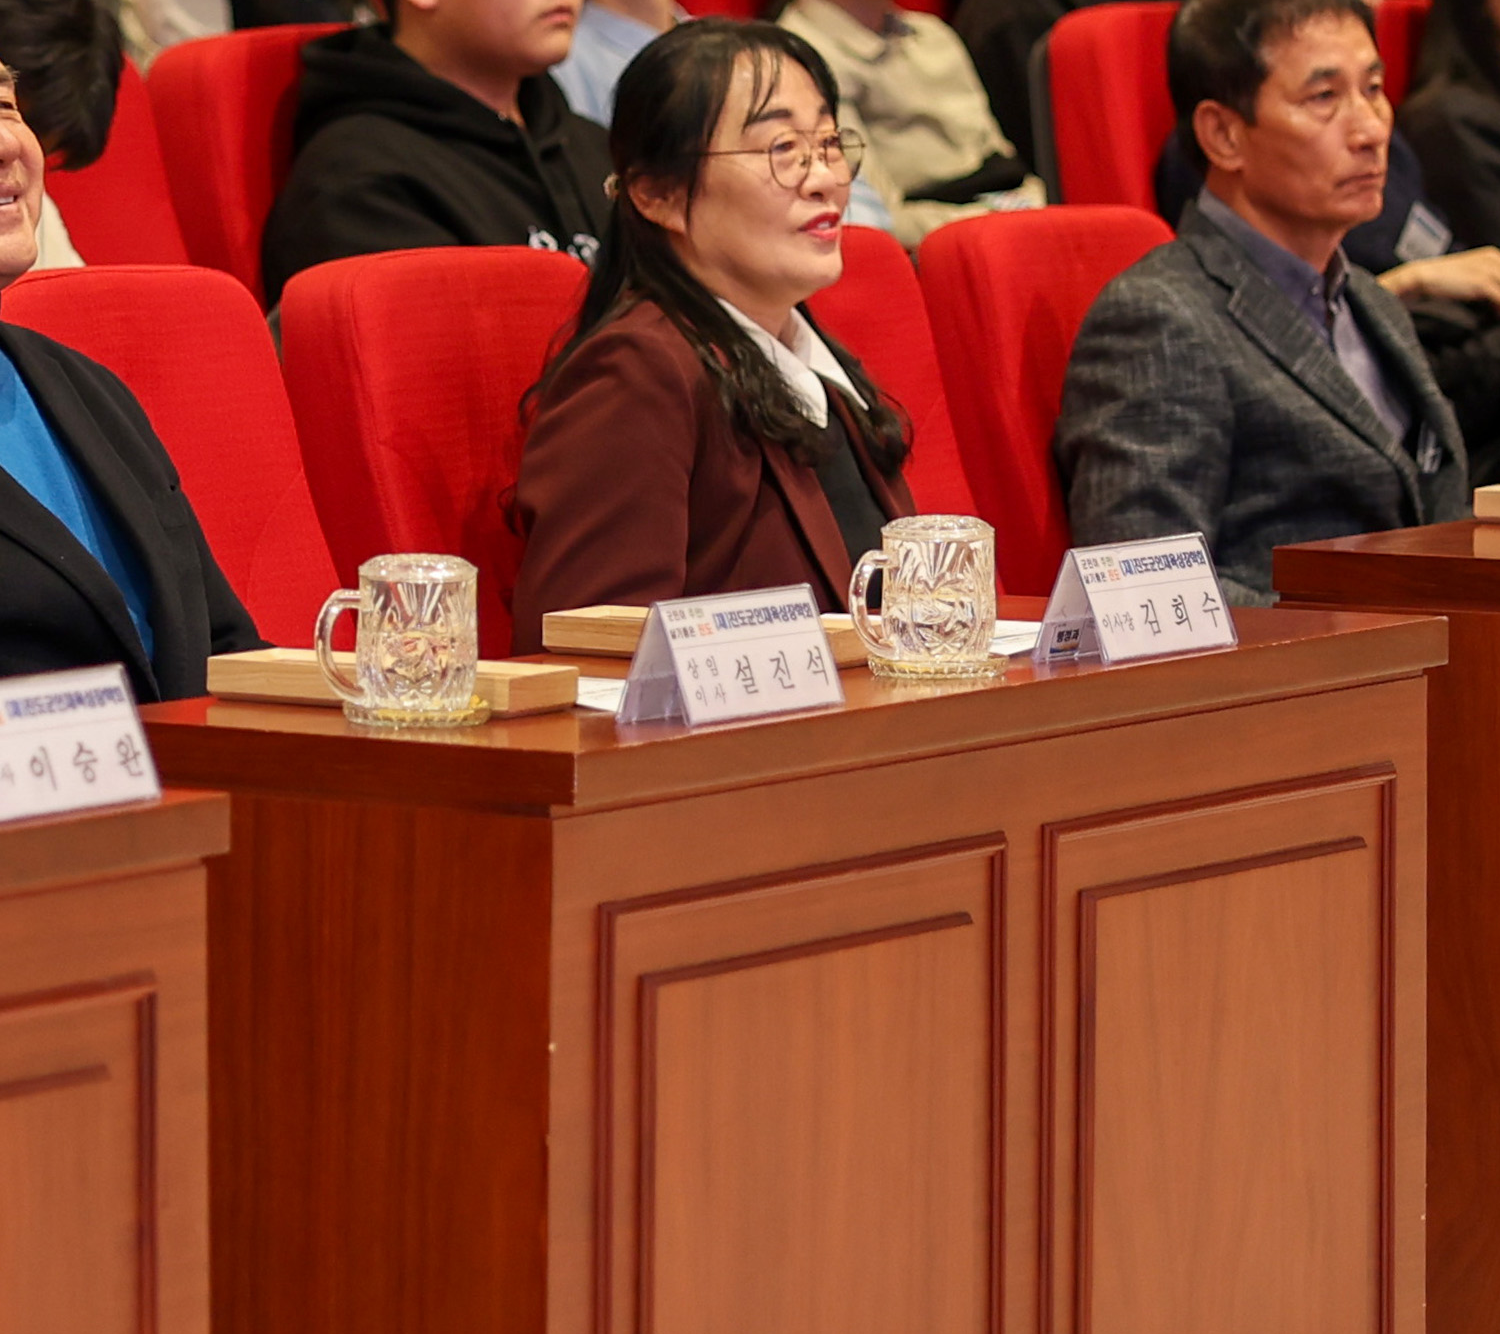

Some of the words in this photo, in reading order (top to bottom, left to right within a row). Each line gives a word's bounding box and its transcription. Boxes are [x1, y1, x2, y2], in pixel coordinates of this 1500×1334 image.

[1102, 612, 1135, 634] 이사장
[1140, 591, 1221, 637] 김희수
[687, 655, 719, 679] 상임
[734, 644, 830, 696] 설진석
[696, 683, 727, 707] 이사
[29, 733, 144, 792] 이승완
